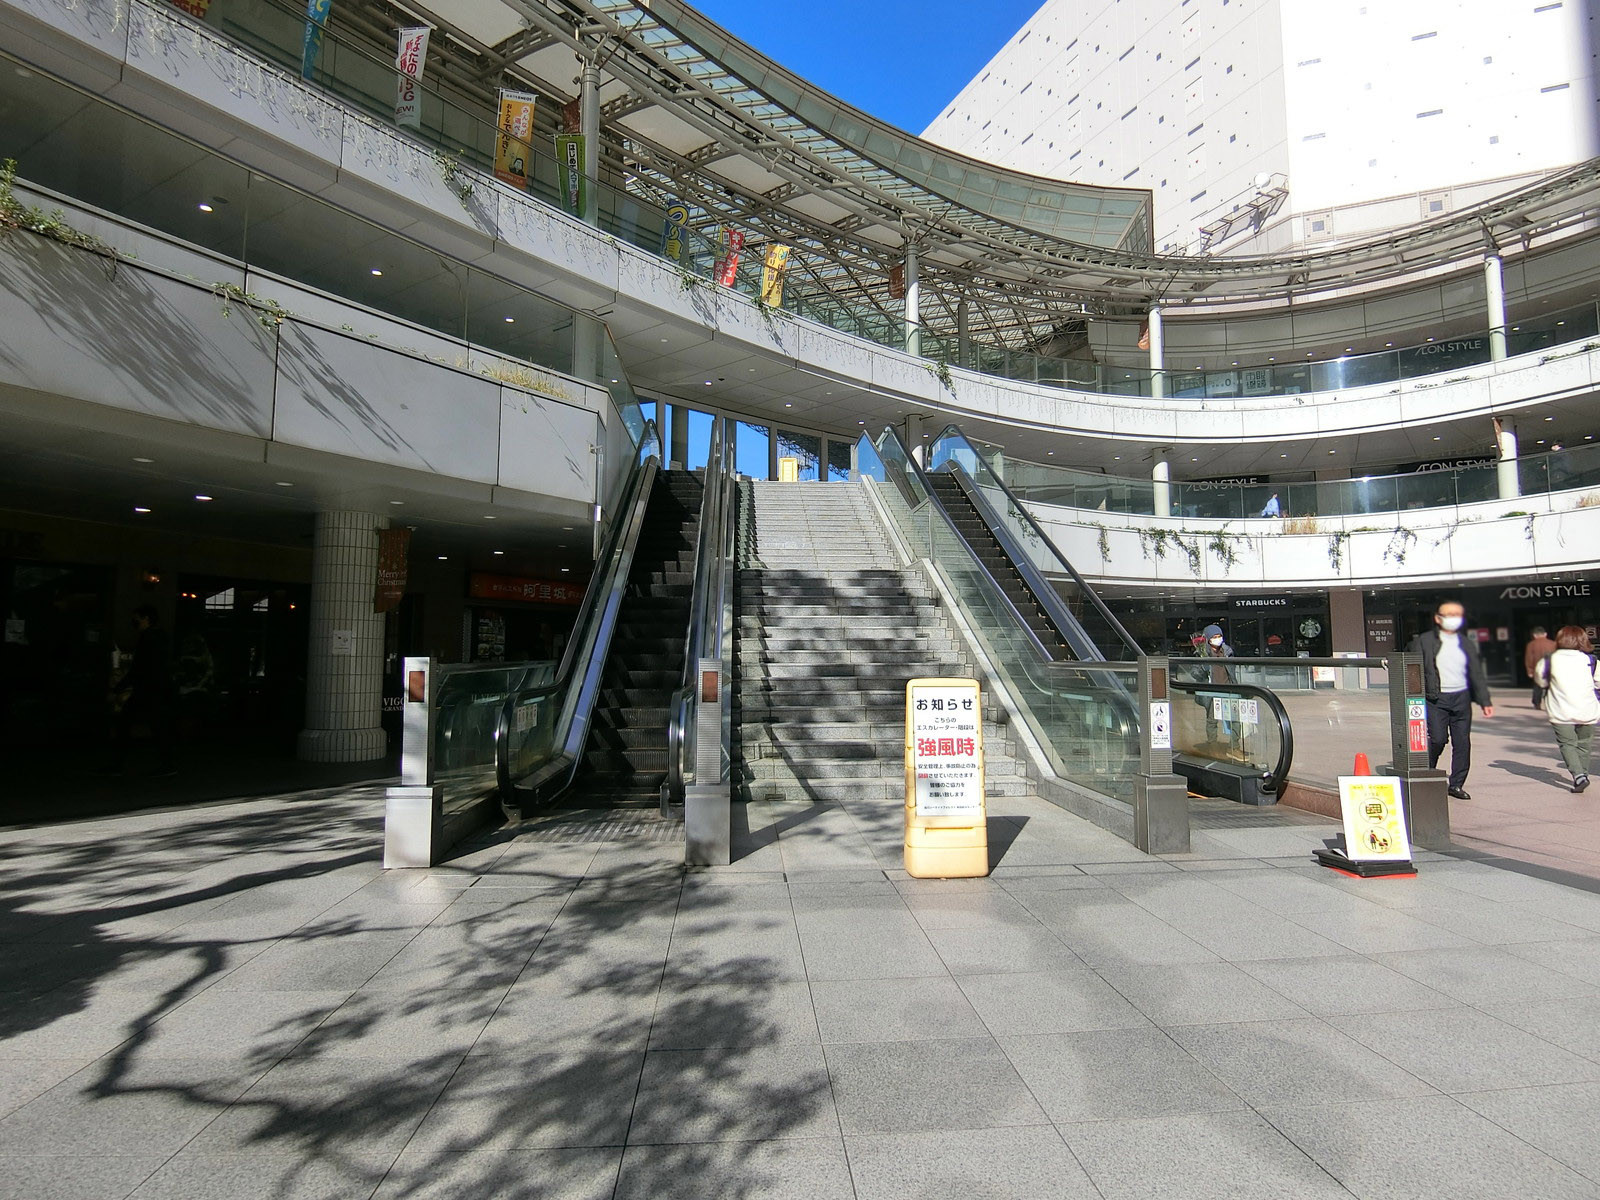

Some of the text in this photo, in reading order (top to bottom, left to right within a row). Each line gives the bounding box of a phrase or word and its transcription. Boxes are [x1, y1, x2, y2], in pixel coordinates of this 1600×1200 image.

[1448, 340, 1481, 352] STYLE
[1456, 458, 1498, 472] STYLE
[1218, 477, 1258, 489] STYLE
[378, 570, 399, 579] Merry
[1544, 584, 1591, 597] STYLE
[1235, 598, 1286, 606] STARBUCKS
[916, 698, 973, 711] お知らせ
[917, 737, 975, 757] 強風時
